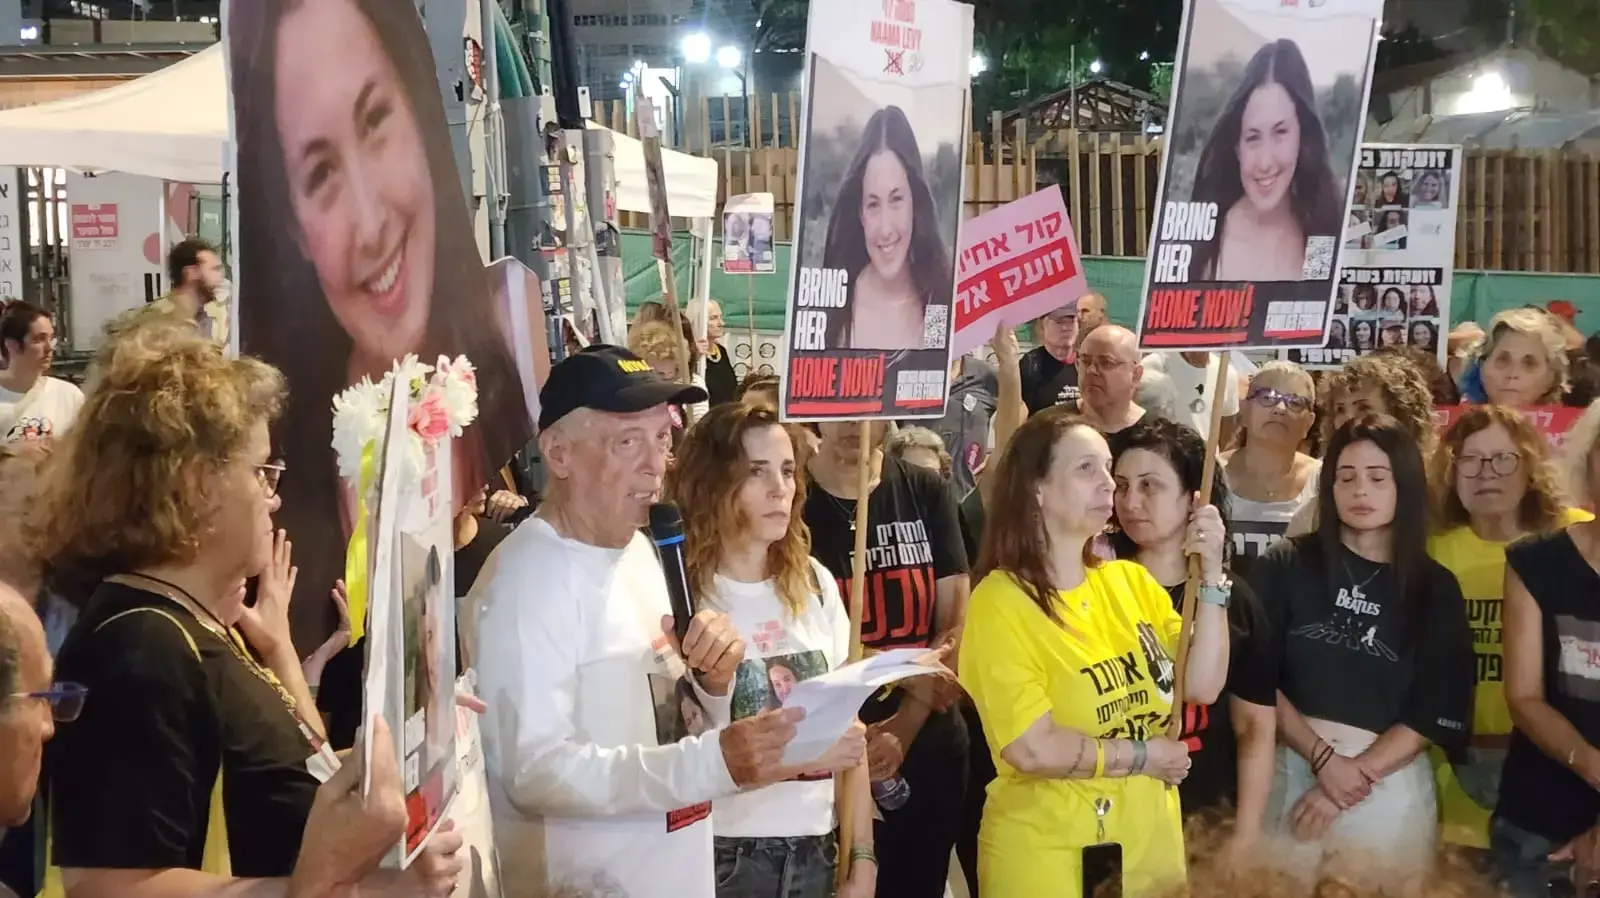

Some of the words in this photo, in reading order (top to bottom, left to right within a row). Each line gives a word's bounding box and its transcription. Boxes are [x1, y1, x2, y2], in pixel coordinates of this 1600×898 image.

[1379, 150, 1447, 174] זועקות
[1014, 211, 1063, 245] קול
[1160, 201, 1219, 242] BRING
[998, 248, 1065, 297] זועק
[1154, 244, 1193, 283] HER
[797, 267, 849, 309] BRING
[1146, 288, 1202, 330] HOME
[1200, 283, 1255, 330] NOW!
[793, 310, 828, 351] HER
[790, 356, 839, 400] HOME
[838, 352, 886, 399] NOW!
[897, 541, 934, 566] אותם
[1335, 588, 1382, 616] BEATLES
